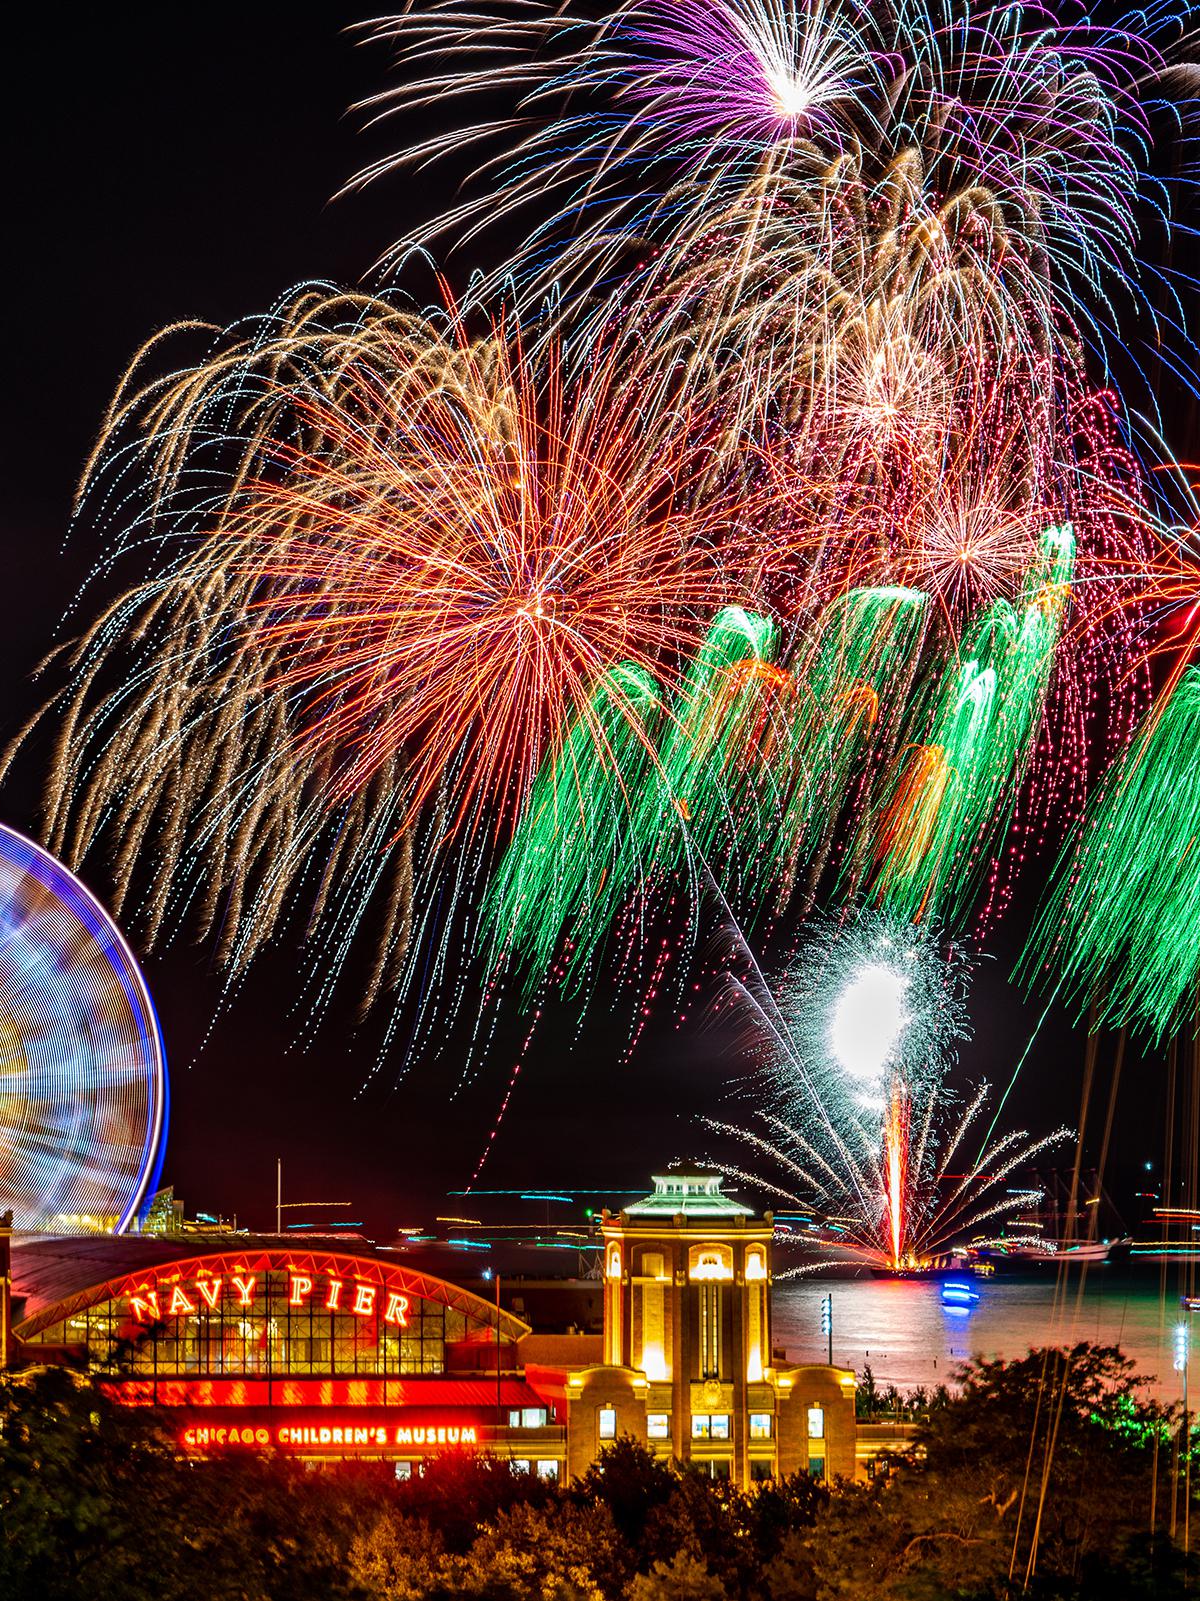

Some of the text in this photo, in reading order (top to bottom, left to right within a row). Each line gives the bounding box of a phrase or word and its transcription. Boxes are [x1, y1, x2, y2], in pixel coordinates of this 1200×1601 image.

[130, 1276, 410, 1327] NAVY PIER
[184, 1427, 477, 1445] CHICAGO CHILDREN'S MUSEUM
